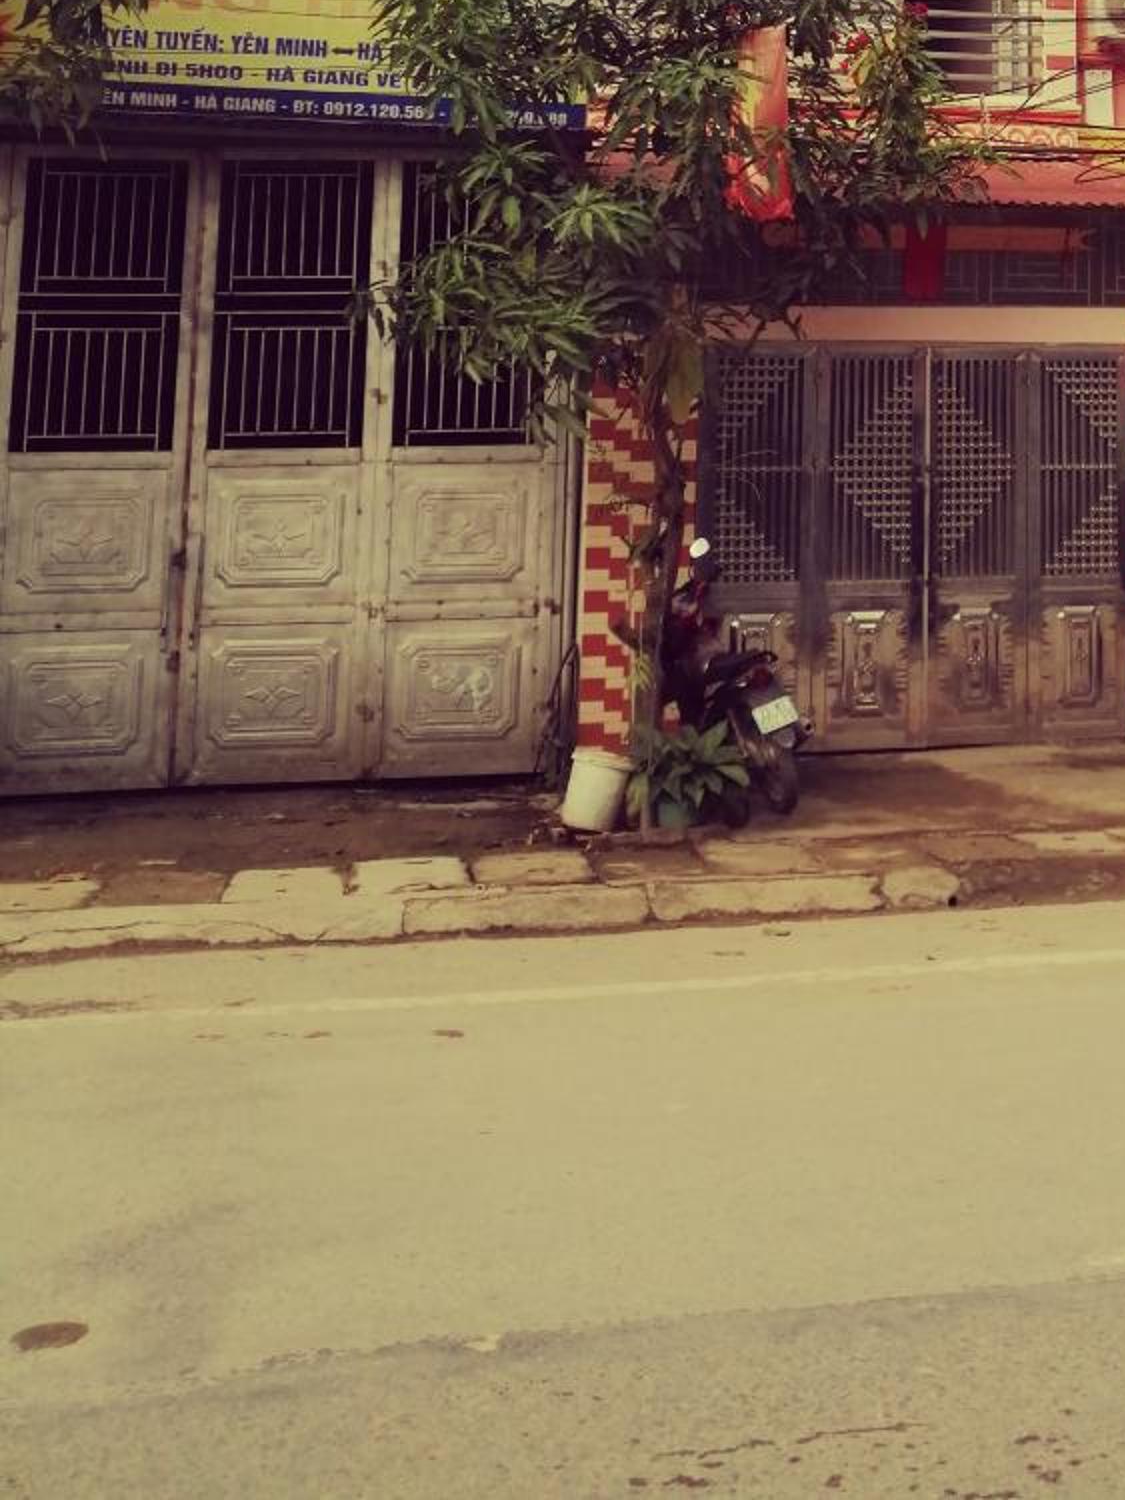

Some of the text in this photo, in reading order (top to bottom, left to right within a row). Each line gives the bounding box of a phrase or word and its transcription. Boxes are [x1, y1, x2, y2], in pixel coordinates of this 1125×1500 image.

[156, 26, 224, 53] TUYẾN:
[231, 32, 268, 54] YÊN
[276, 38, 327, 58] MINH
[186, 63, 242, 80] 5H00
[267, 66, 294, 82] HÀ
[303, 69, 368, 87] GIANG
[131, 92, 176, 107] MINH
[195, 93, 217, 110] HÀ
[224, 97, 276, 113] GIANG
[294, 100, 319, 115] ĐT:
